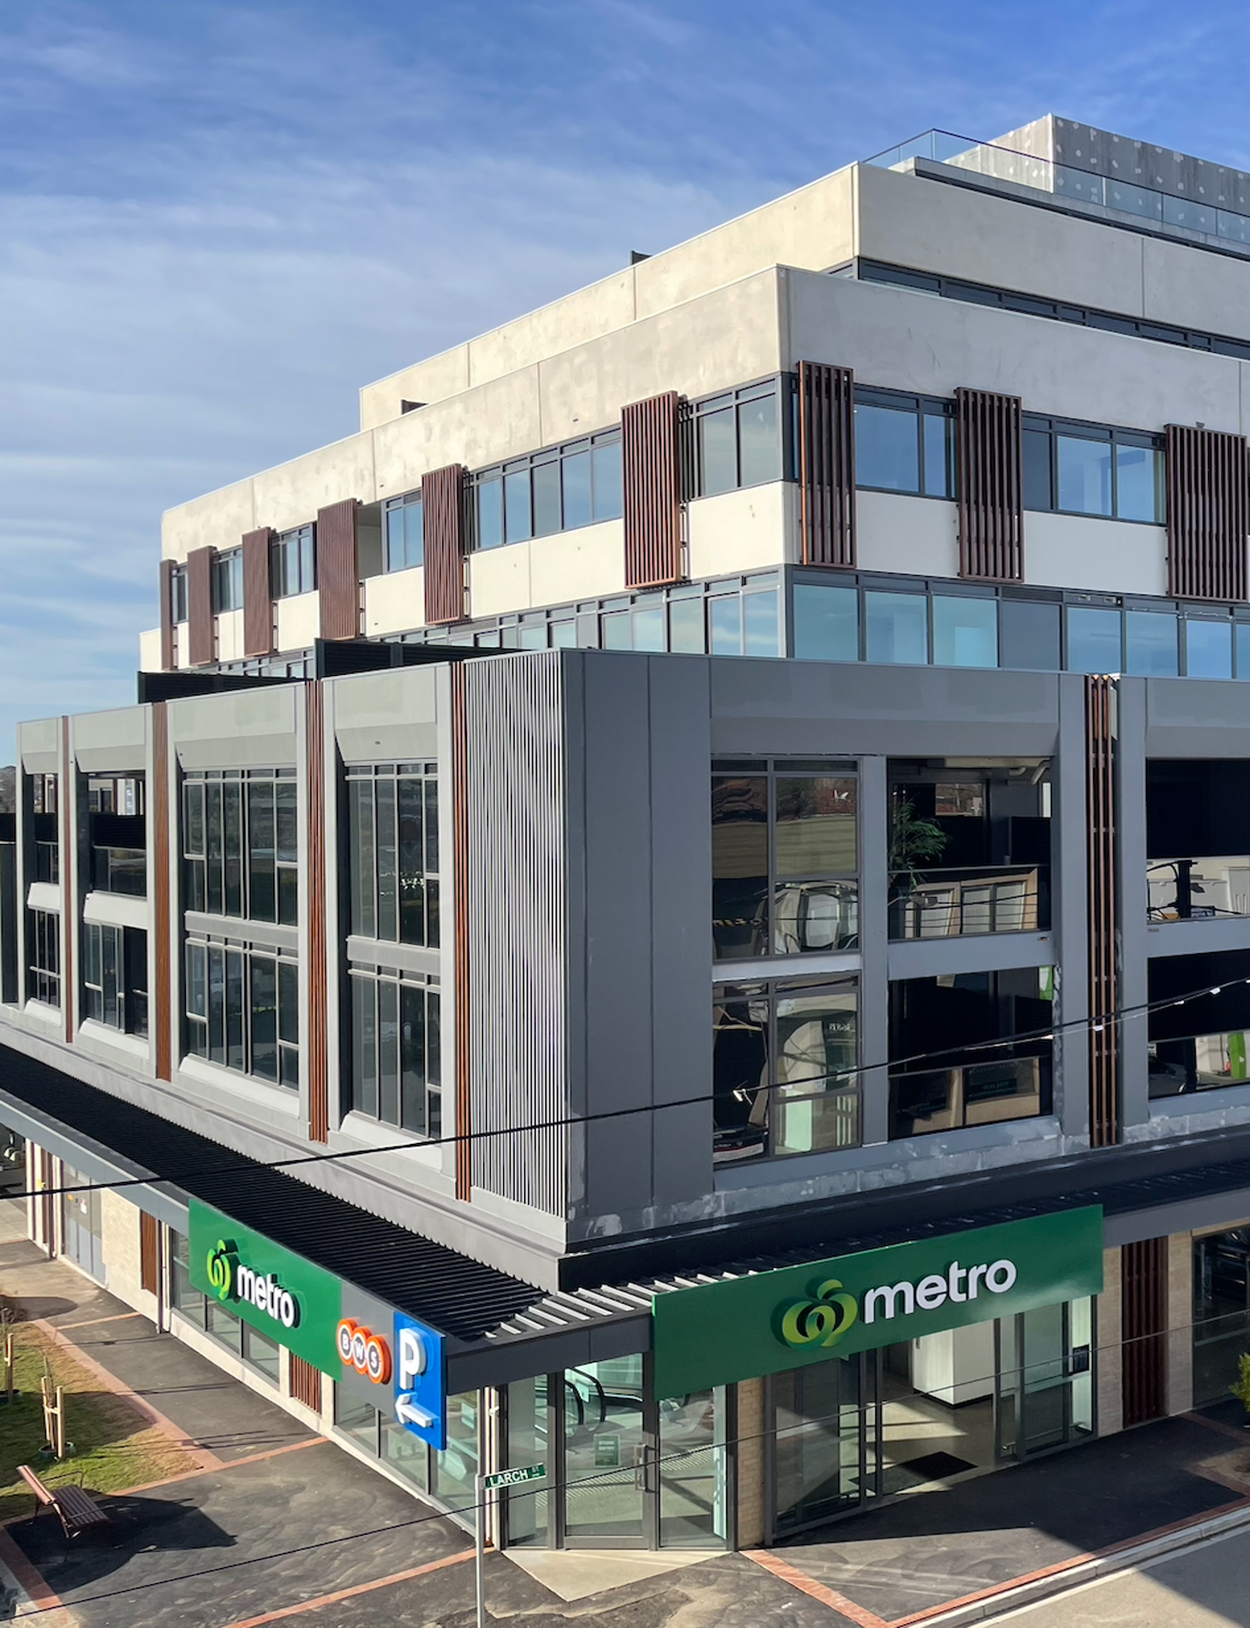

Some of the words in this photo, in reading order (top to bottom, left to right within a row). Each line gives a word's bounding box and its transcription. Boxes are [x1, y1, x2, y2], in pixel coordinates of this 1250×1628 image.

[237, 1265, 295, 1327] metro
[864, 1259, 1017, 1324] metro
[340, 1328, 380, 1375] BWS
[400, 1328, 425, 1390] P
[489, 1468, 529, 1487] LARCH
